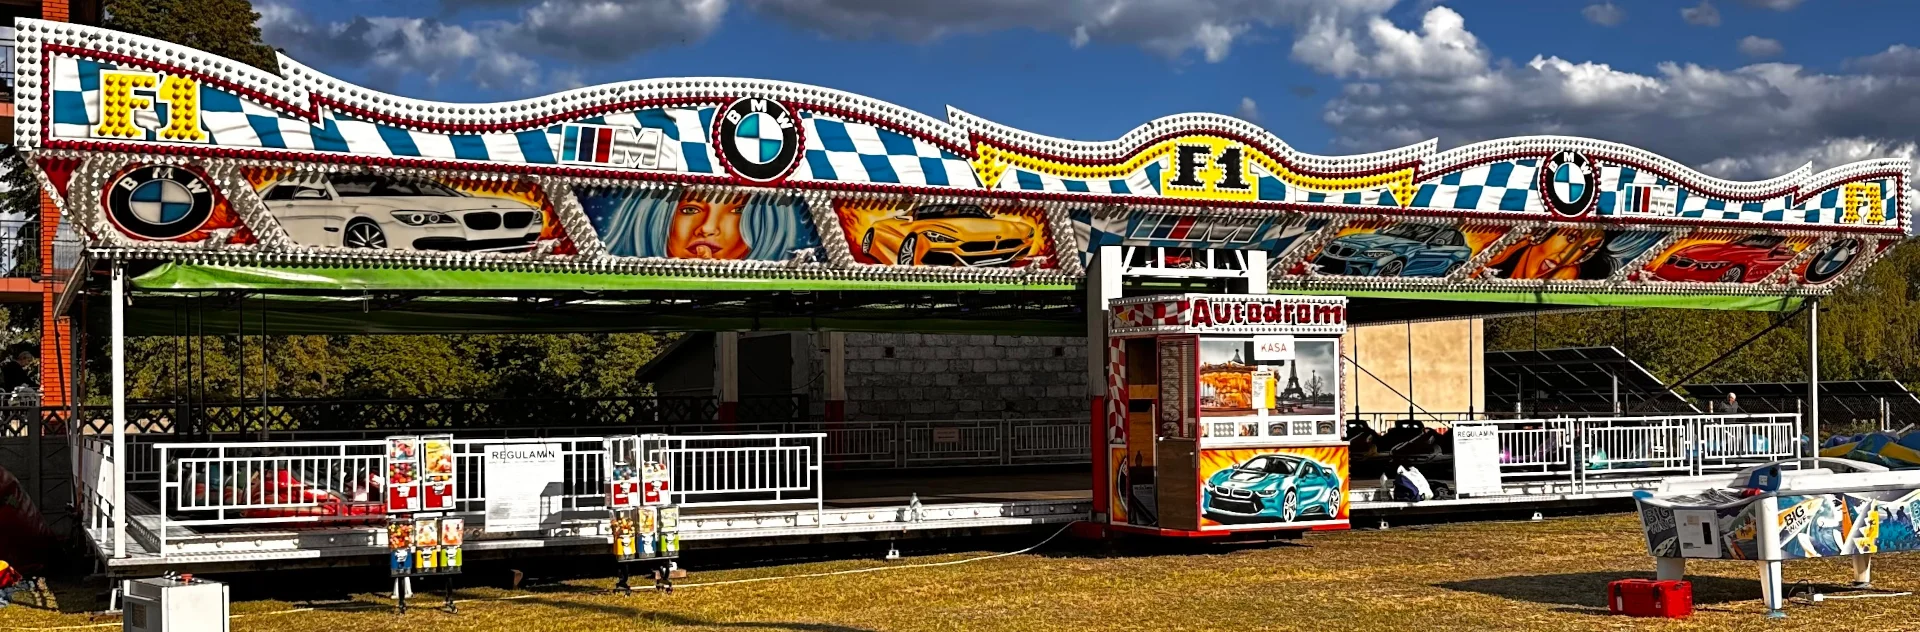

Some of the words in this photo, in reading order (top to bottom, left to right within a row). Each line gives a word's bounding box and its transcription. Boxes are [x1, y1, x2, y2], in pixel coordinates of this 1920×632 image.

[93, 70, 207, 142] F1
[726, 98, 793, 130] BMW
[1170, 143, 1251, 190] F1
[1548, 152, 1592, 176] BMW
[119, 167, 208, 194] BMW
[1843, 183, 1885, 224] F1
[1191, 299, 1342, 327] Autodrom
[1261, 343, 1287, 353] KASA
[1458, 430, 1494, 438] REGULAMIN
[491, 450, 555, 460] REGULAMIN
[1644, 506, 1671, 524] BIG
[1784, 505, 1805, 527] BIG
